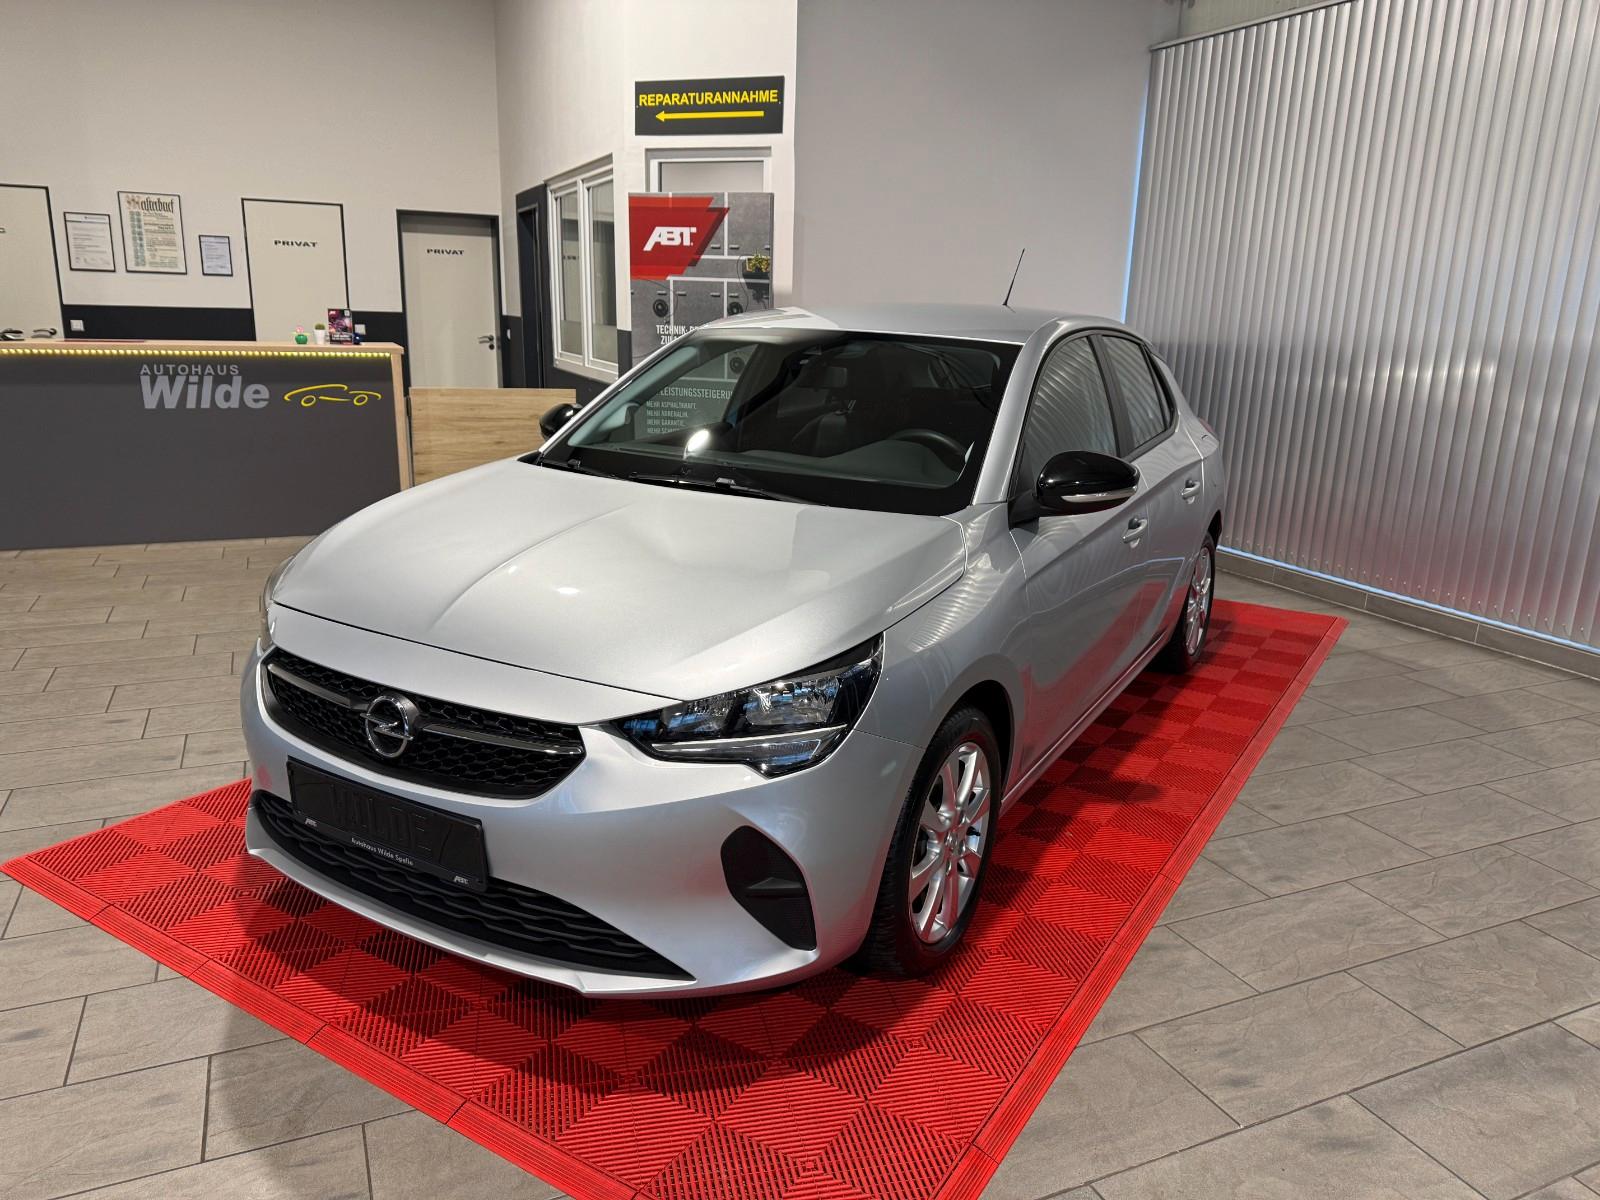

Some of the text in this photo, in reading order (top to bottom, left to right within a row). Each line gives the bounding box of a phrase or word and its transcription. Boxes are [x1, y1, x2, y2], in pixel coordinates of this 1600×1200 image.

[639, 90, 778, 107] REPARATURANNAHME
[274, 239, 318, 248] PRIVAT
[643, 226, 697, 251] ABT
[426, 248, 465, 256] PRIVAT
[140, 364, 240, 375] AUTOHAUS
[140, 375, 270, 409] Wilde
